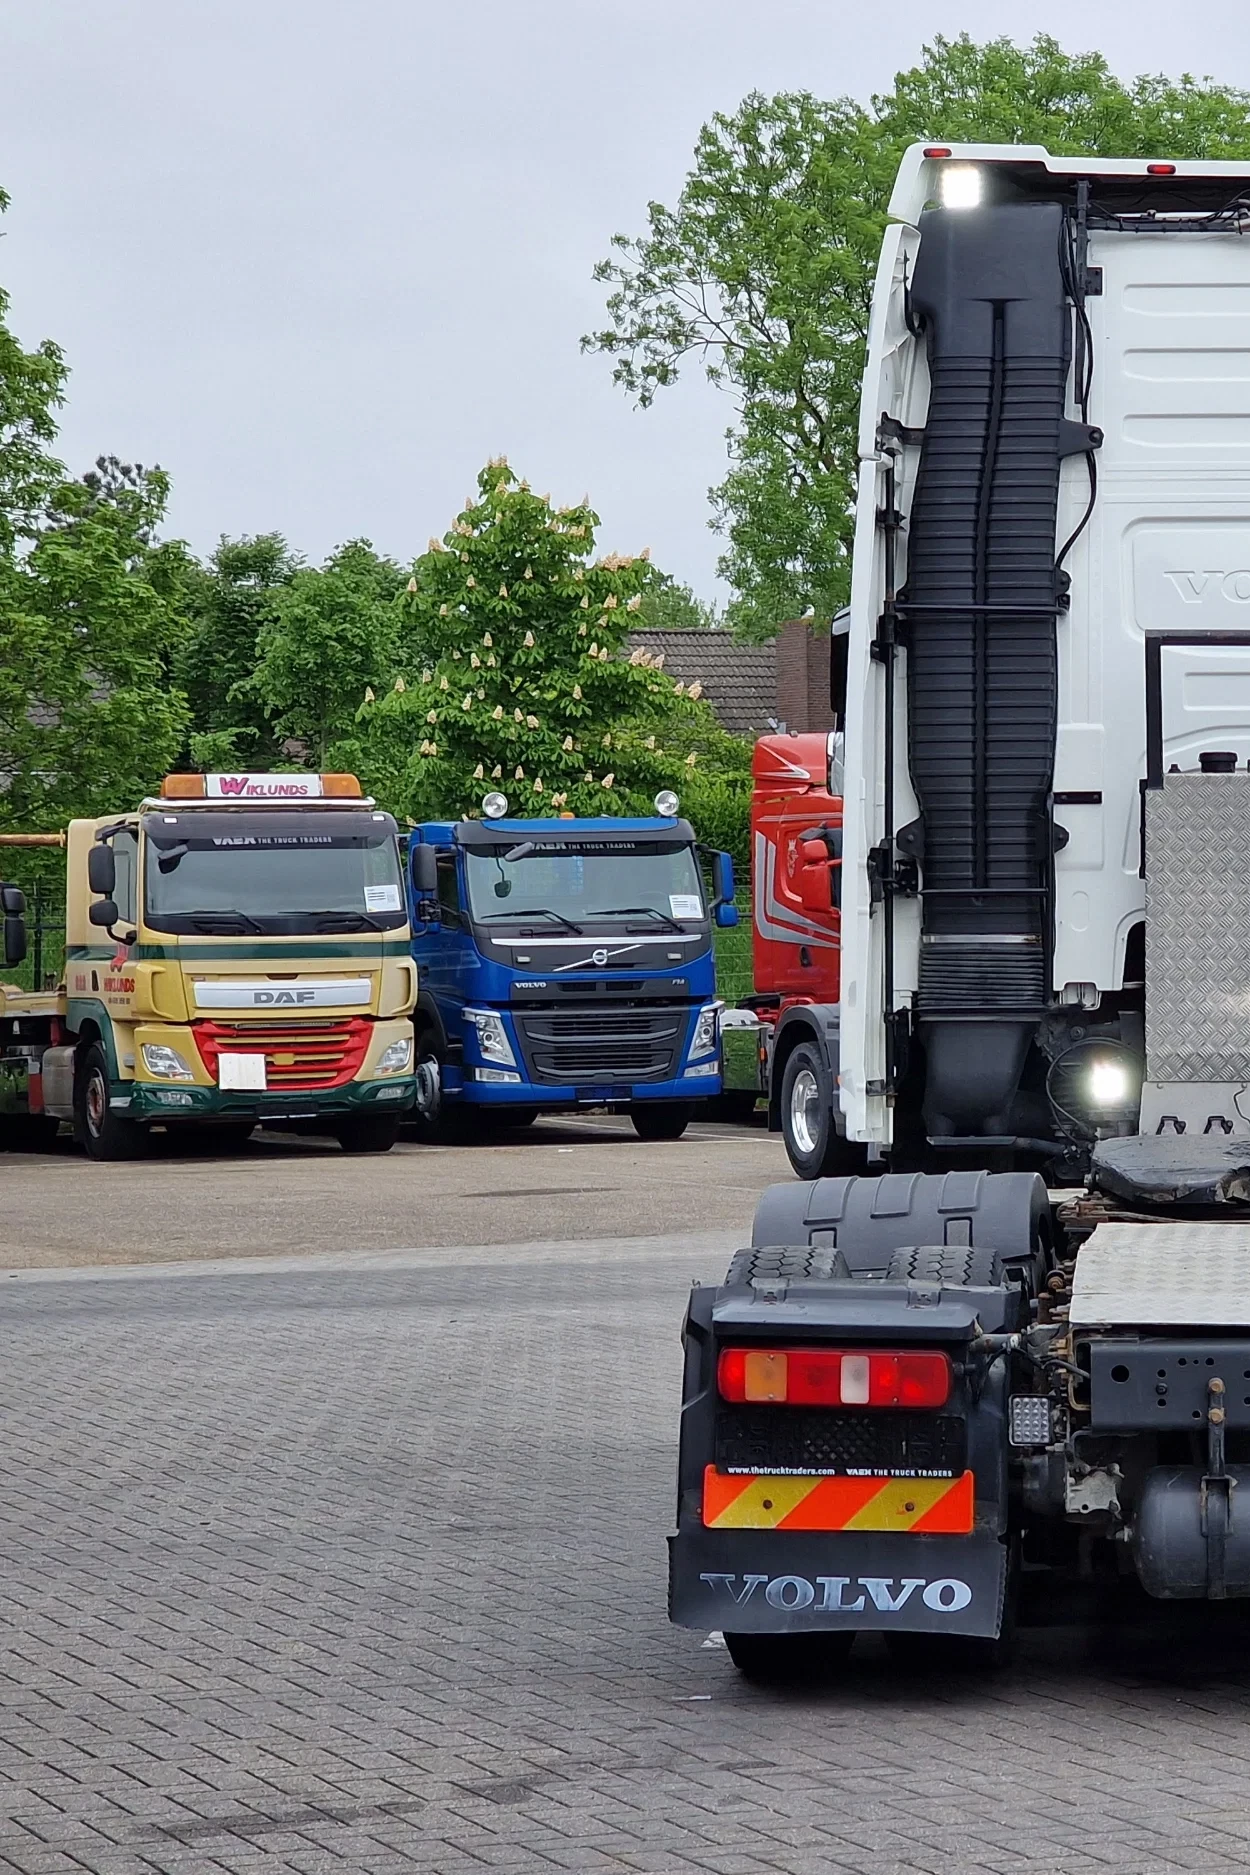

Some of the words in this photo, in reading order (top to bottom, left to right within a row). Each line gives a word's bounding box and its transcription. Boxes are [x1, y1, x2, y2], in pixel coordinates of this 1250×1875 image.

[219, 776, 309, 796] WIKLUNDS
[299, 836, 332, 844] TRADERS
[605, 842, 636, 850] TRADERS
[253, 991, 316, 1004] DAF
[727, 1466, 836, 1475] www.thetrucktraders.com
[890, 1469, 916, 1477] TRUCK
[917, 1469, 953, 1478] TRADERS
[699, 1572, 973, 1613] VOLVO
